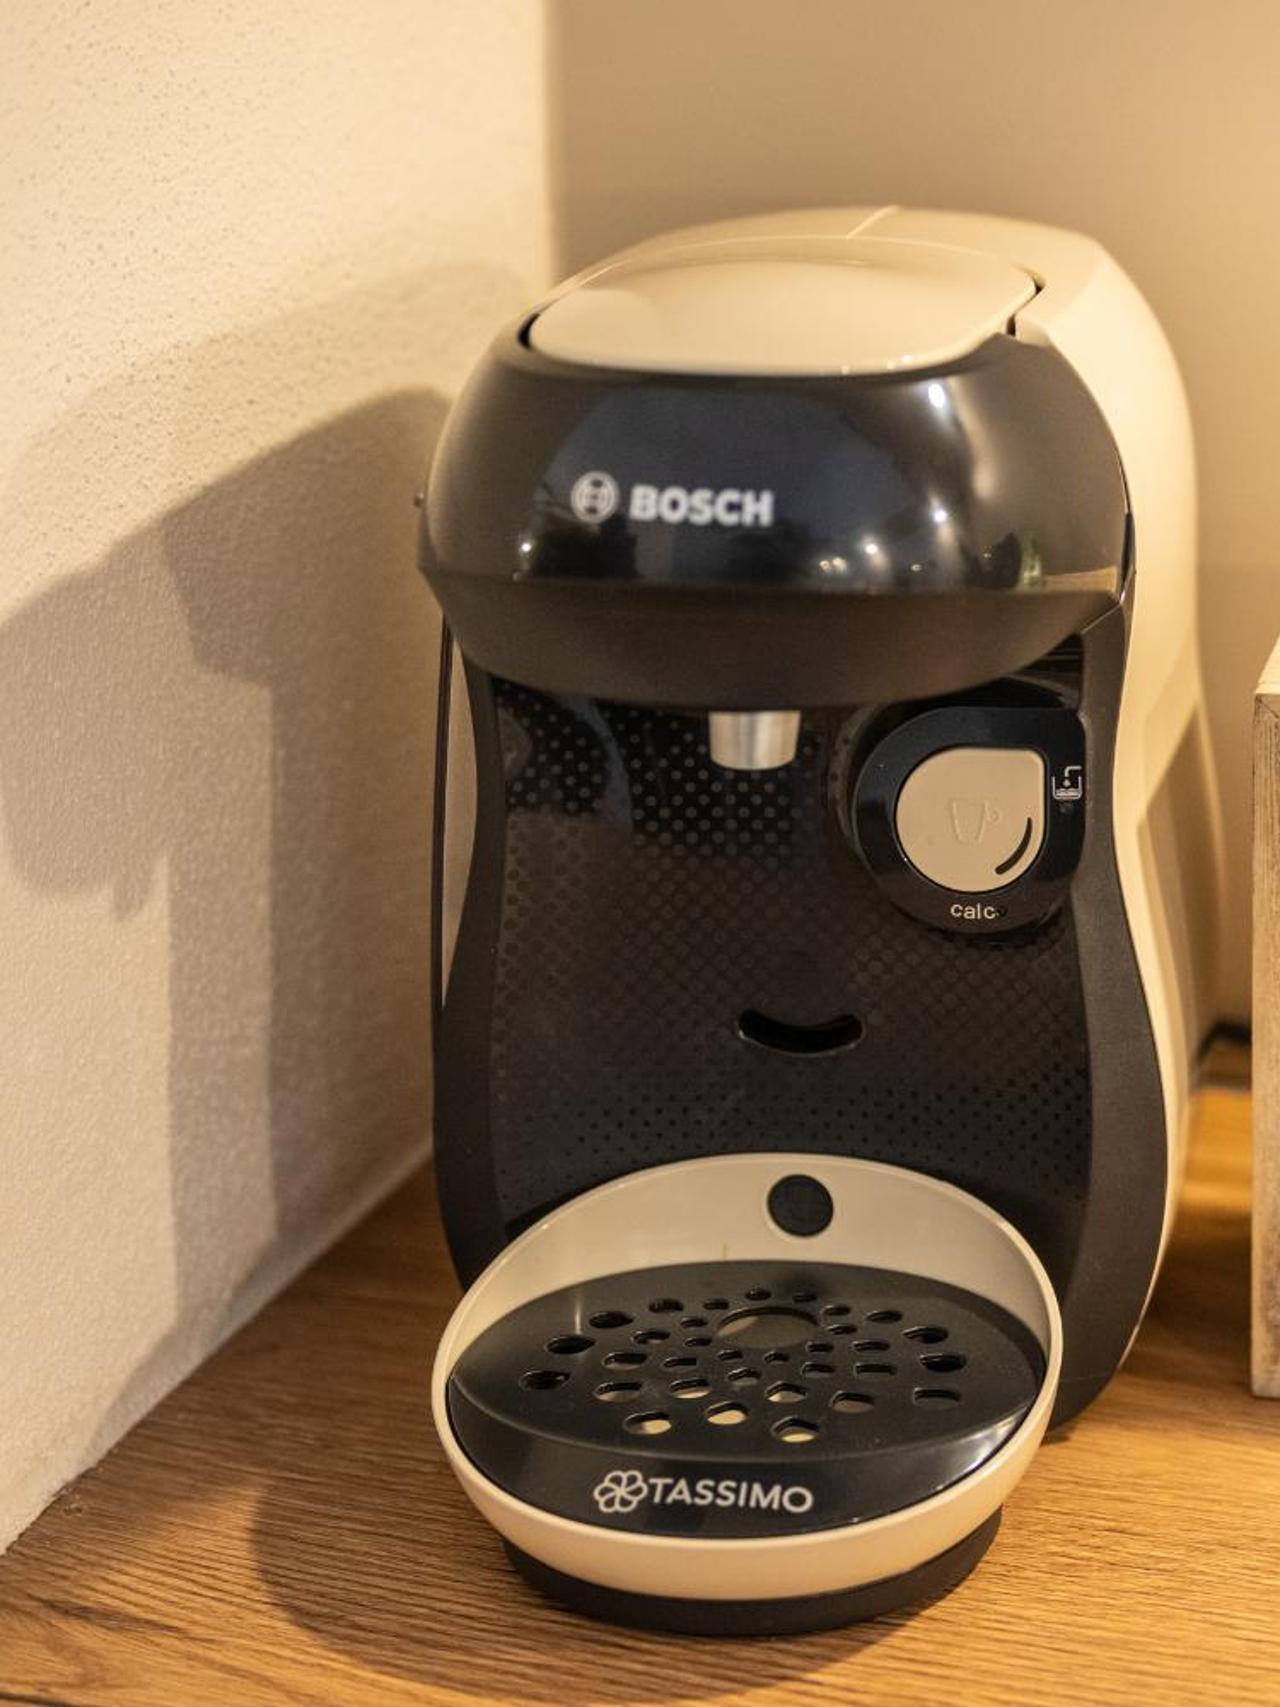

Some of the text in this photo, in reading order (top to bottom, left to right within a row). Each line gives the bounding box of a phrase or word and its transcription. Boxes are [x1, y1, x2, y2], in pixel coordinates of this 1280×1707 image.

[630, 484, 775, 528] BOSCH
[950, 903, 997, 920] calc
[649, 1477, 814, 1514] TASSIMO
